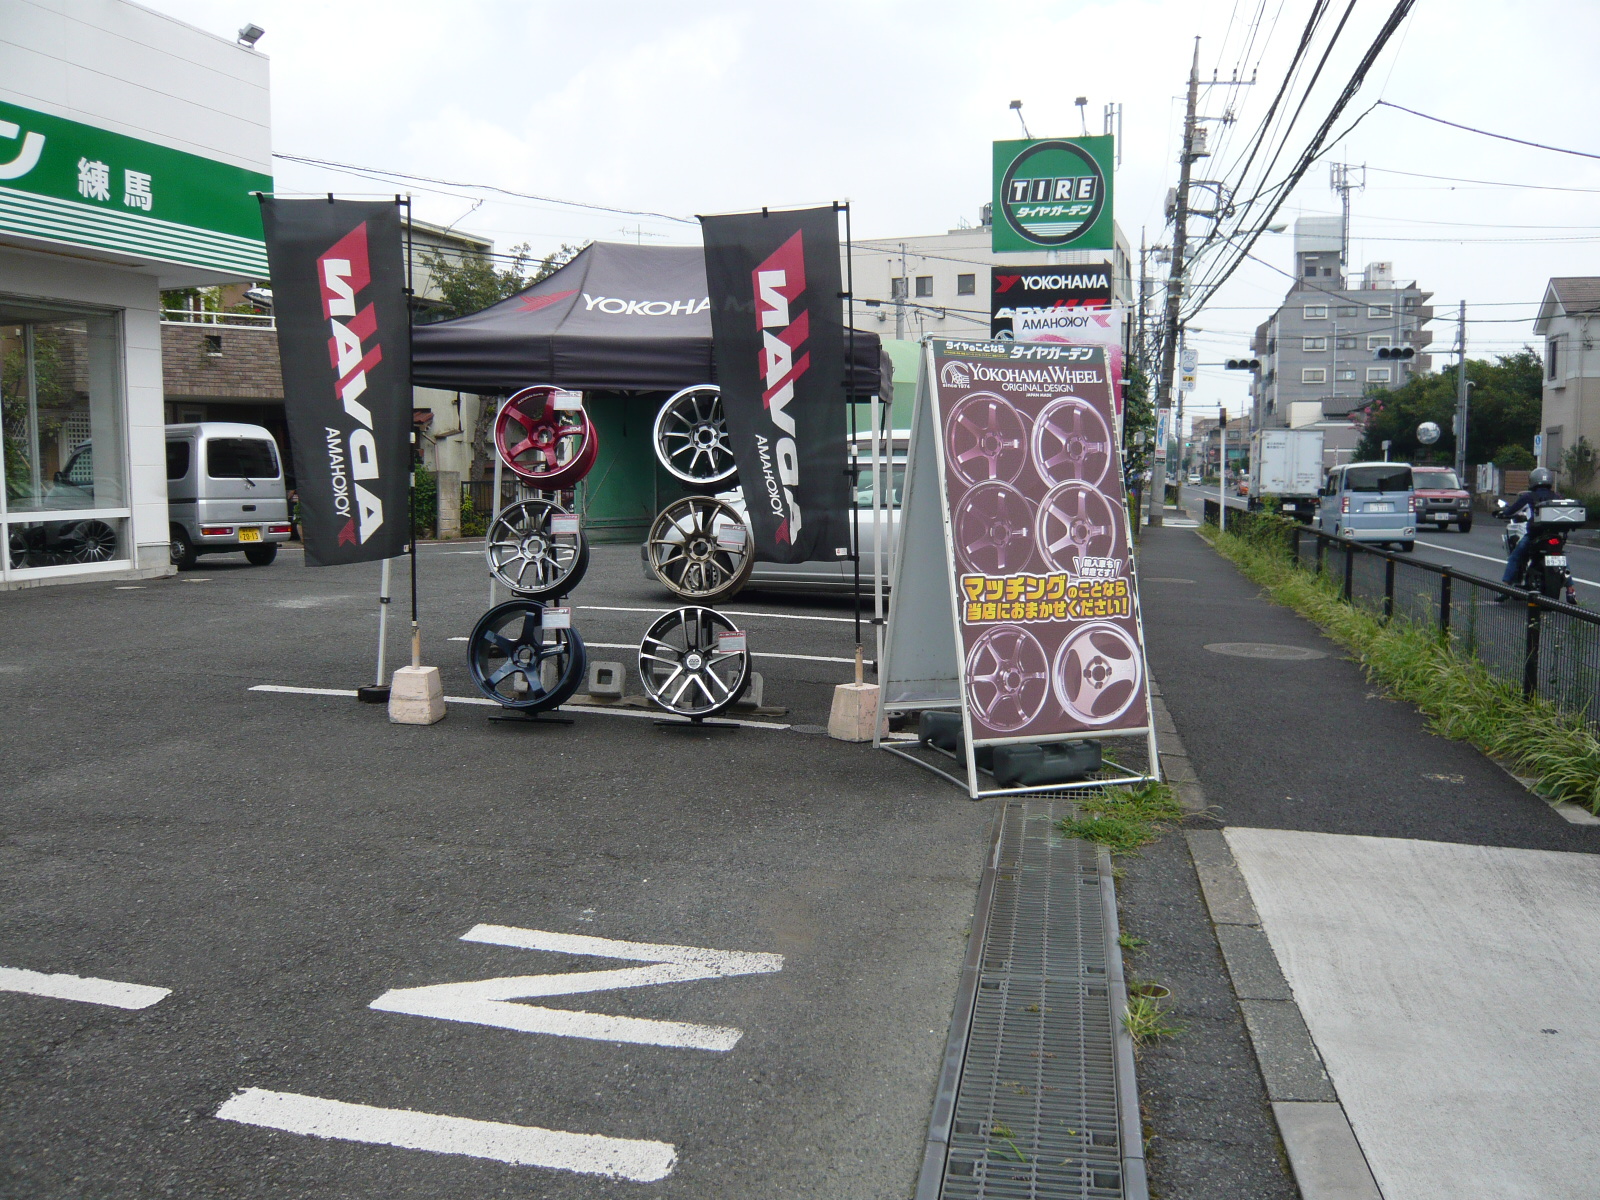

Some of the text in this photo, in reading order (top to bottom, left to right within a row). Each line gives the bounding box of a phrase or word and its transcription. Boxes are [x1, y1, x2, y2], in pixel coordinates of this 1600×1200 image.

[77, 156, 153, 211] 練馬
[1013, 179, 1093, 201] TIRE
[1016, 204, 1093, 217] タイヤガーデン
[1020, 274, 1108, 290] YOKOHAMA
[583, 293, 711, 316] YOKOHA
[1010, 345, 1093, 360] タイヤガーデン
[967, 362, 1103, 384] YOKOHAMA WHEEL
[1001, 383, 1073, 392] ORIGINAL DESIGN
[964, 575, 1126, 600] マッチングのことなら
[967, 598, 1128, 620] 当店におまかせください！
